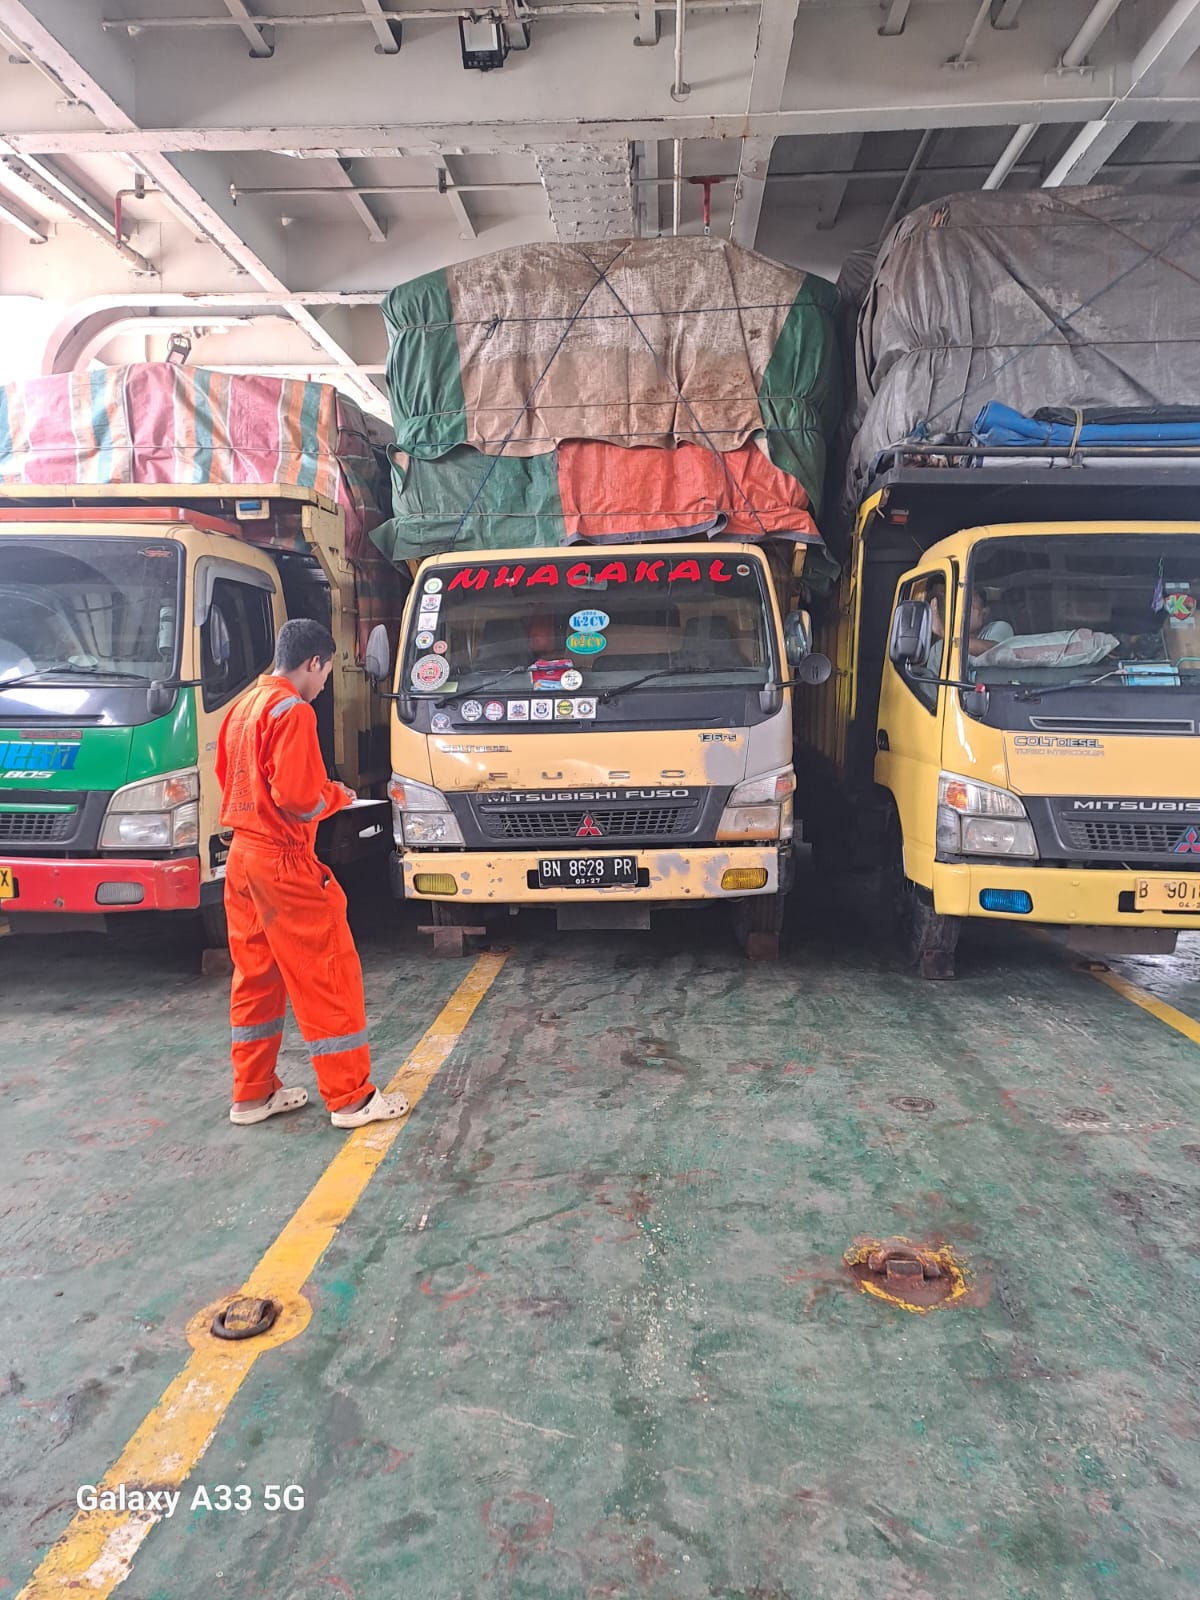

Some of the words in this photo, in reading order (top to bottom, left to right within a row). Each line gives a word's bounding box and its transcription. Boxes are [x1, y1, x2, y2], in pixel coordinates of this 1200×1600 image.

[625, 789, 689, 799] FUSO
[542, 860, 561, 877] BN
[569, 859, 604, 876] 8628
[614, 858, 632, 876] PR
[1139, 880, 1149, 898] B
